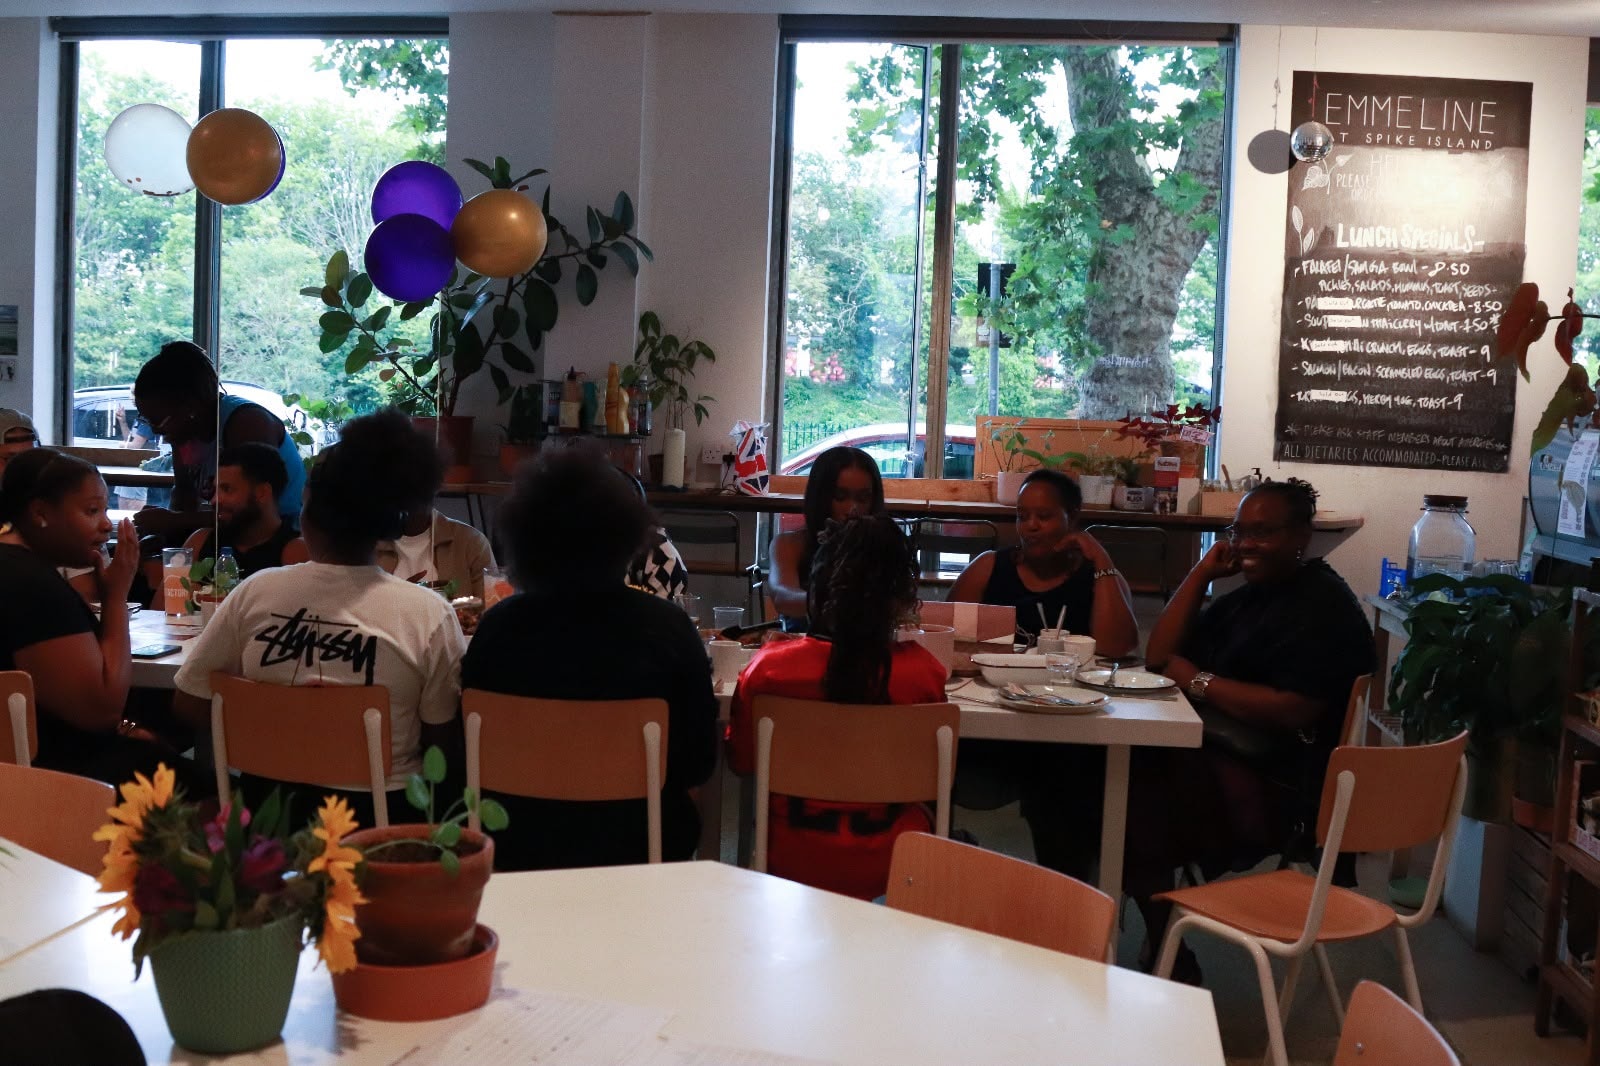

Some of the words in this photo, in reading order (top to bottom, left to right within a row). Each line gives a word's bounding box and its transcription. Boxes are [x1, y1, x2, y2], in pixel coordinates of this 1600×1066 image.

[1325, 93, 1497, 135] EMMELINE
[1366, 133, 1416, 146] SPIKE
[1428, 136, 1493, 150] ISLAND
[1337, 223, 1398, 248] LUNCH
[1284, 444, 1301, 457] ALL
[1304, 445, 1358, 460] DIETARIES
